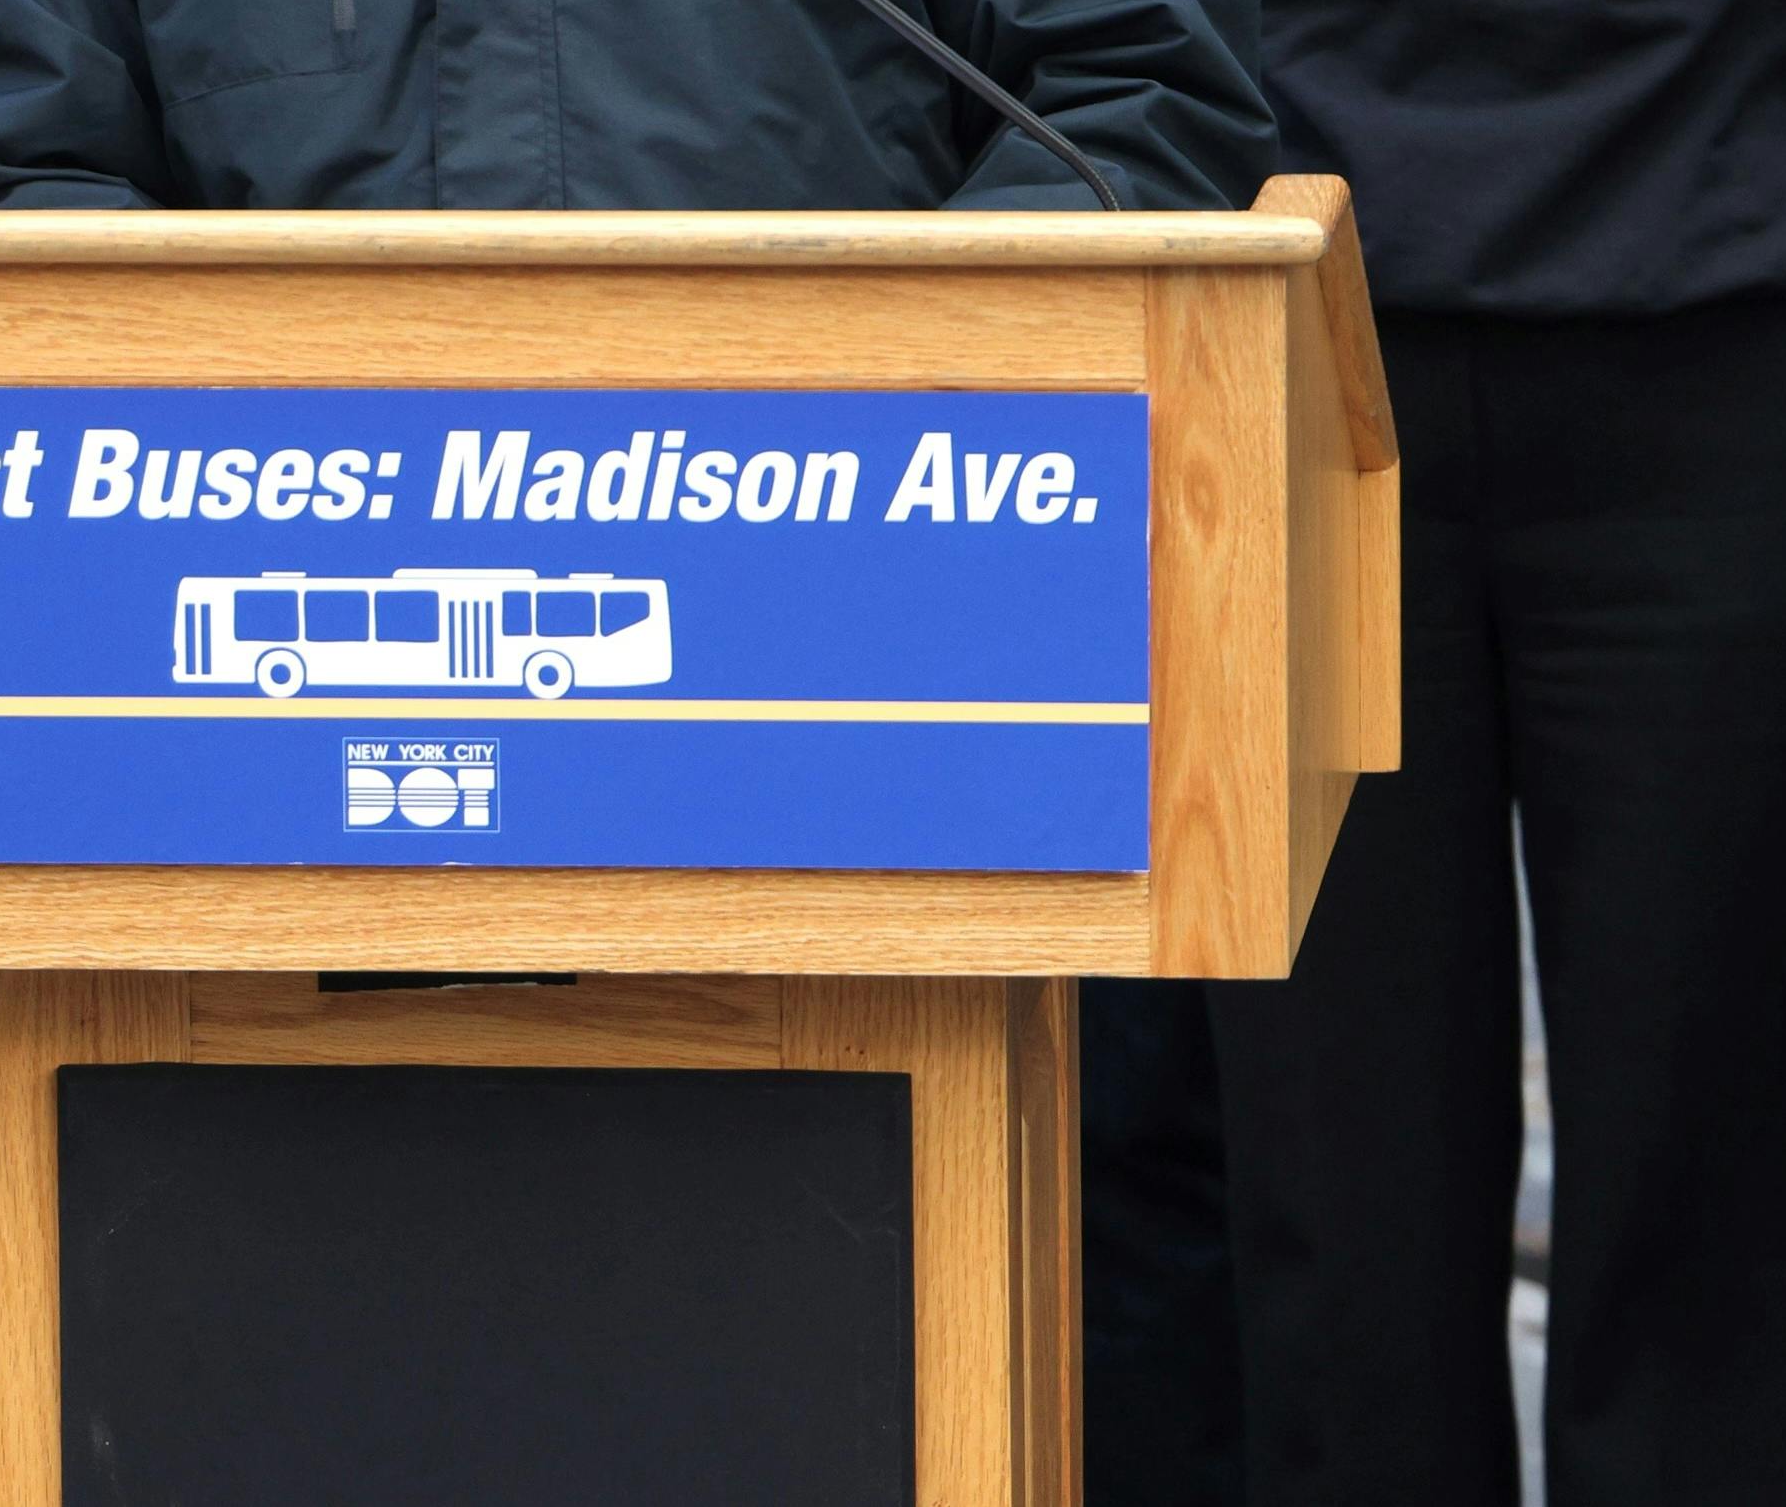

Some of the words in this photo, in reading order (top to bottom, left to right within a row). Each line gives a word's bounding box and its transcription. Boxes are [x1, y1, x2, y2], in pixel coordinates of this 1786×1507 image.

[67, 428, 402, 521] Buses:
[431, 430, 860, 523] Madison
[884, 432, 1098, 525] Ave.
[347, 743, 389, 761] NEW
[398, 743, 447, 761] YORK
[453, 744, 495, 761] CITY
[347, 767, 495, 827] DOT
